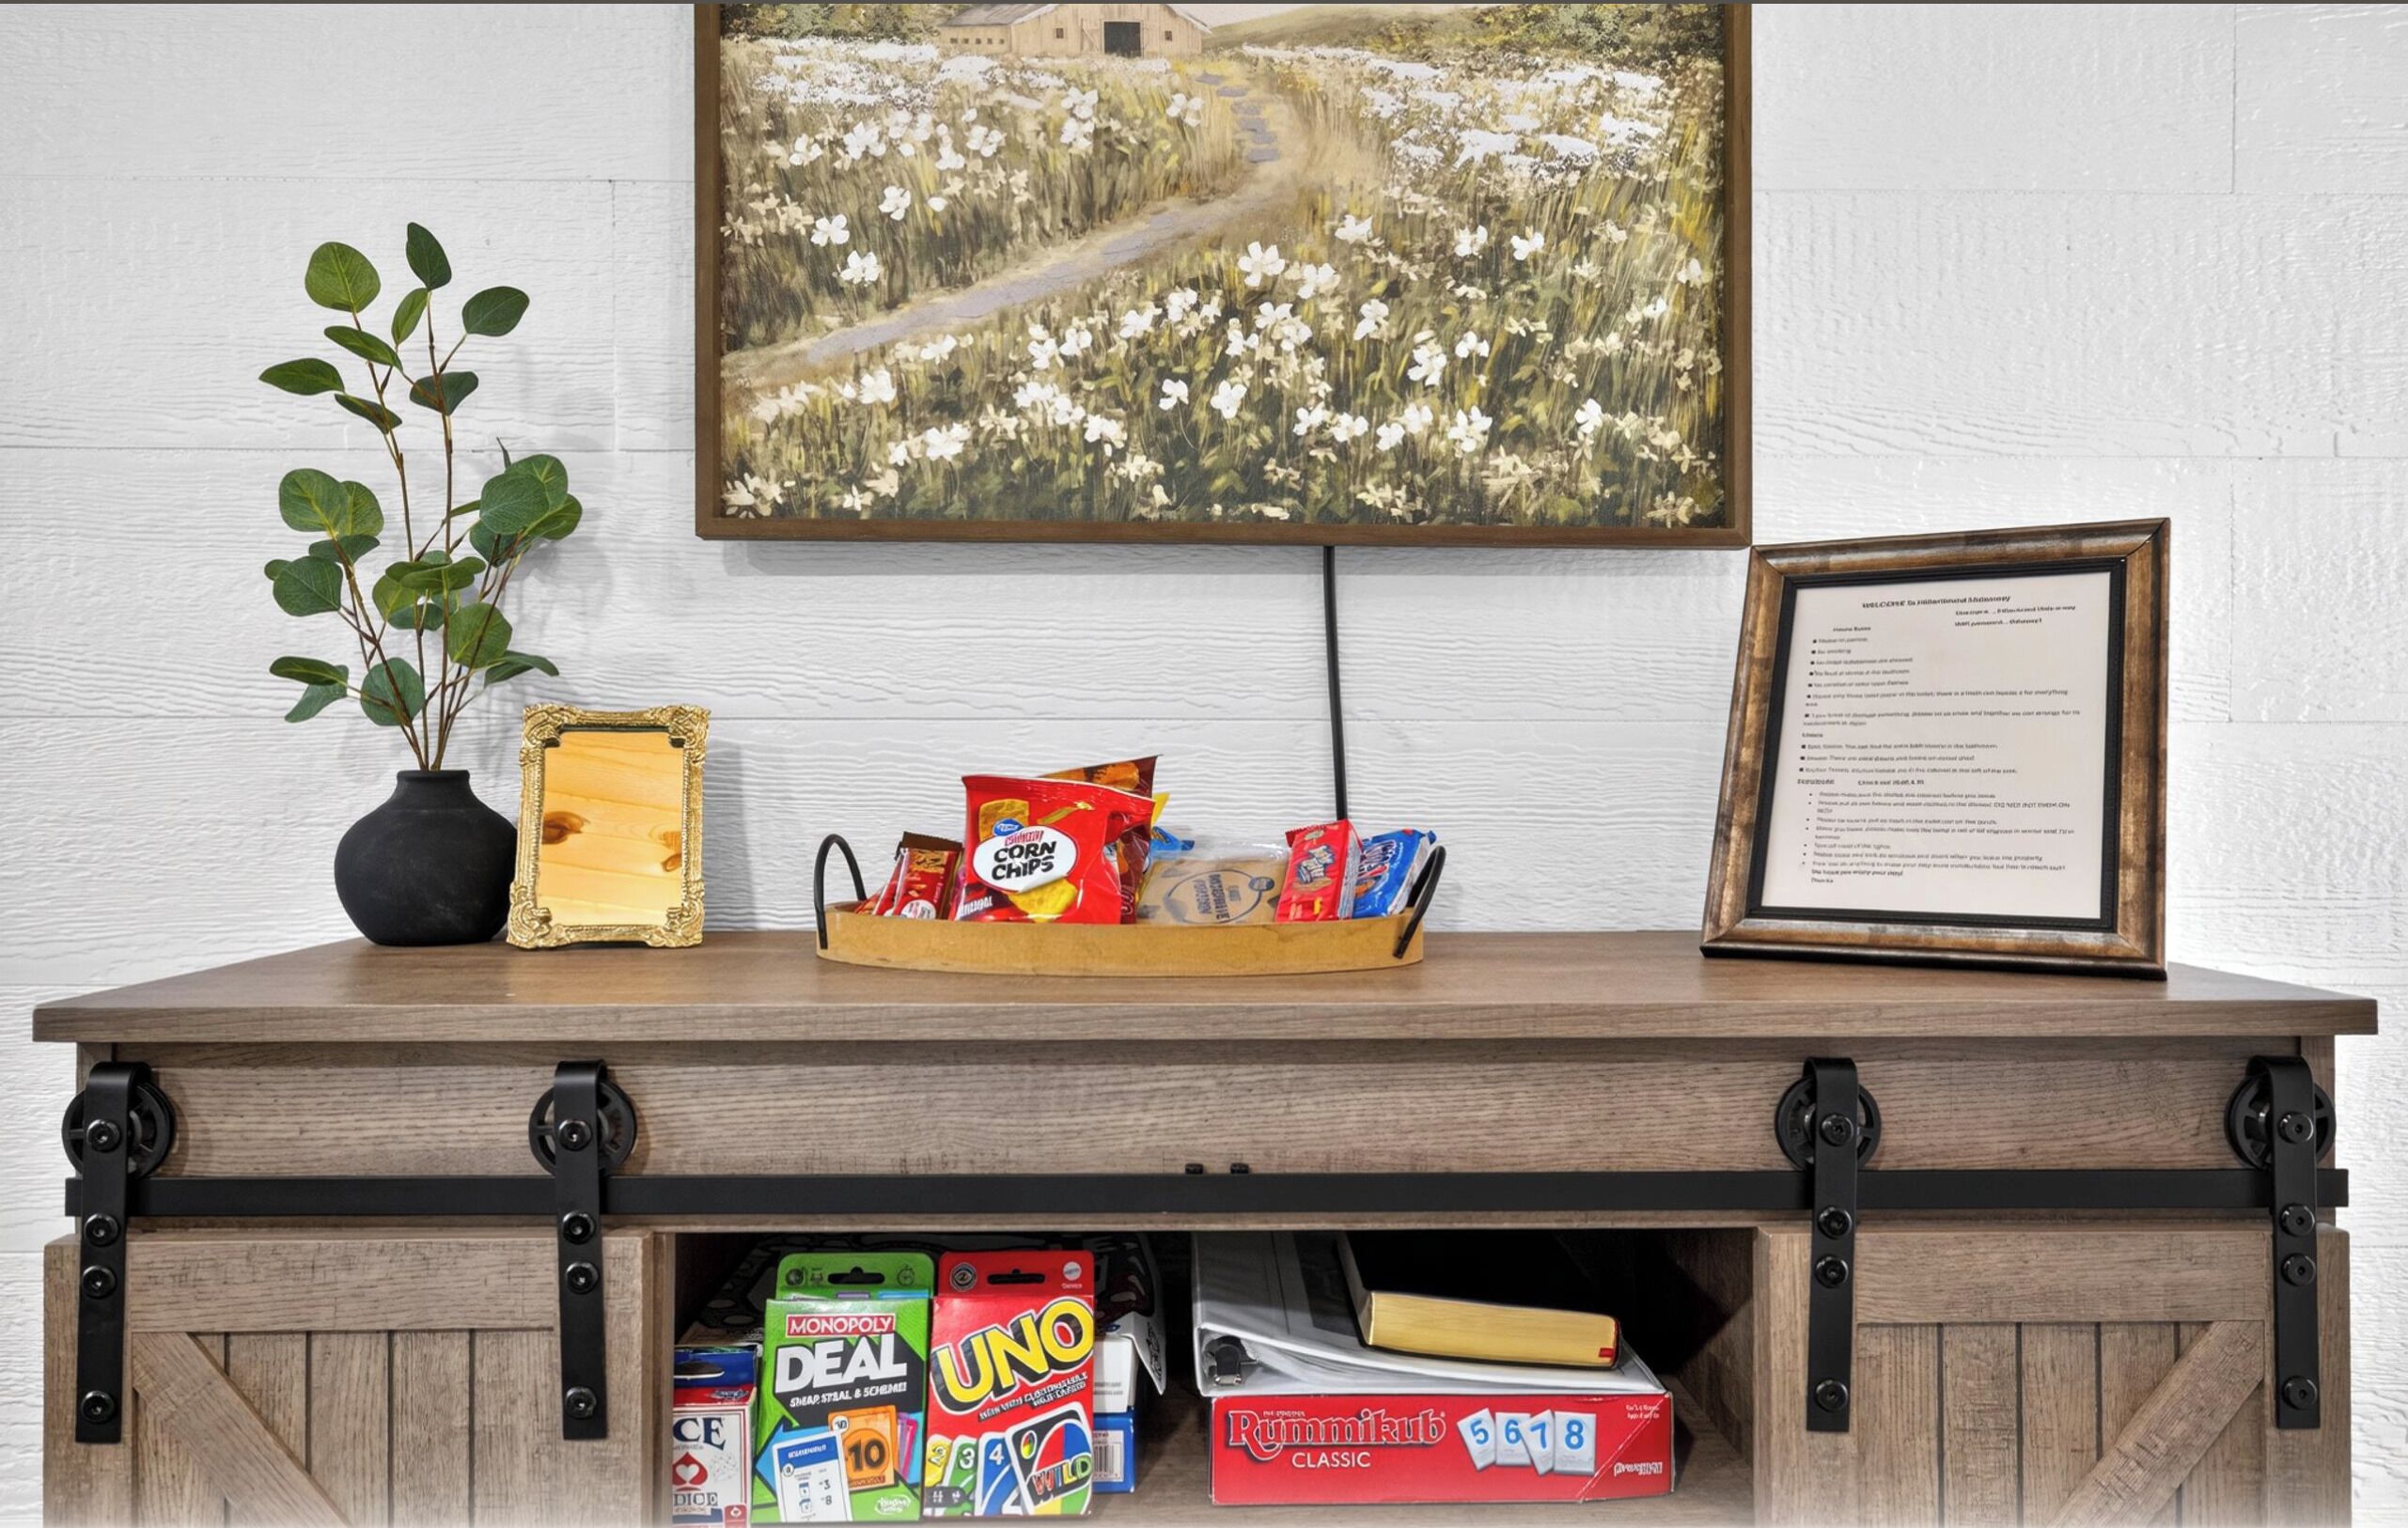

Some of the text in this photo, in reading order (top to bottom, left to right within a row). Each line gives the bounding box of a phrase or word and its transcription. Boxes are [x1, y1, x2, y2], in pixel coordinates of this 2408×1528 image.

[993, 841, 1056, 863] CORN
[992, 855, 1055, 881] CHIPS
[789, 1316, 892, 1335] MONOPOLY
[774, 1333, 908, 1394] DEAL
[931, 1297, 1094, 1410] UNO
[673, 1417, 726, 1451] CE
[1228, 1409, 1446, 1460] Rummikub
[1470, 1419, 1490, 1445] 5
[1504, 1419, 1522, 1445] 6
[1529, 1422, 1547, 1449] 7
[1564, 1419, 1585, 1450] 8
[848, 1438, 886, 1473] 10
[959, 1448, 976, 1470] 3
[989, 1443, 1005, 1466] 4
[1291, 1452, 1371, 1469] CLASSIC
[1032, 1455, 1092, 1496] WILD
[674, 1492, 719, 1507] DICE
